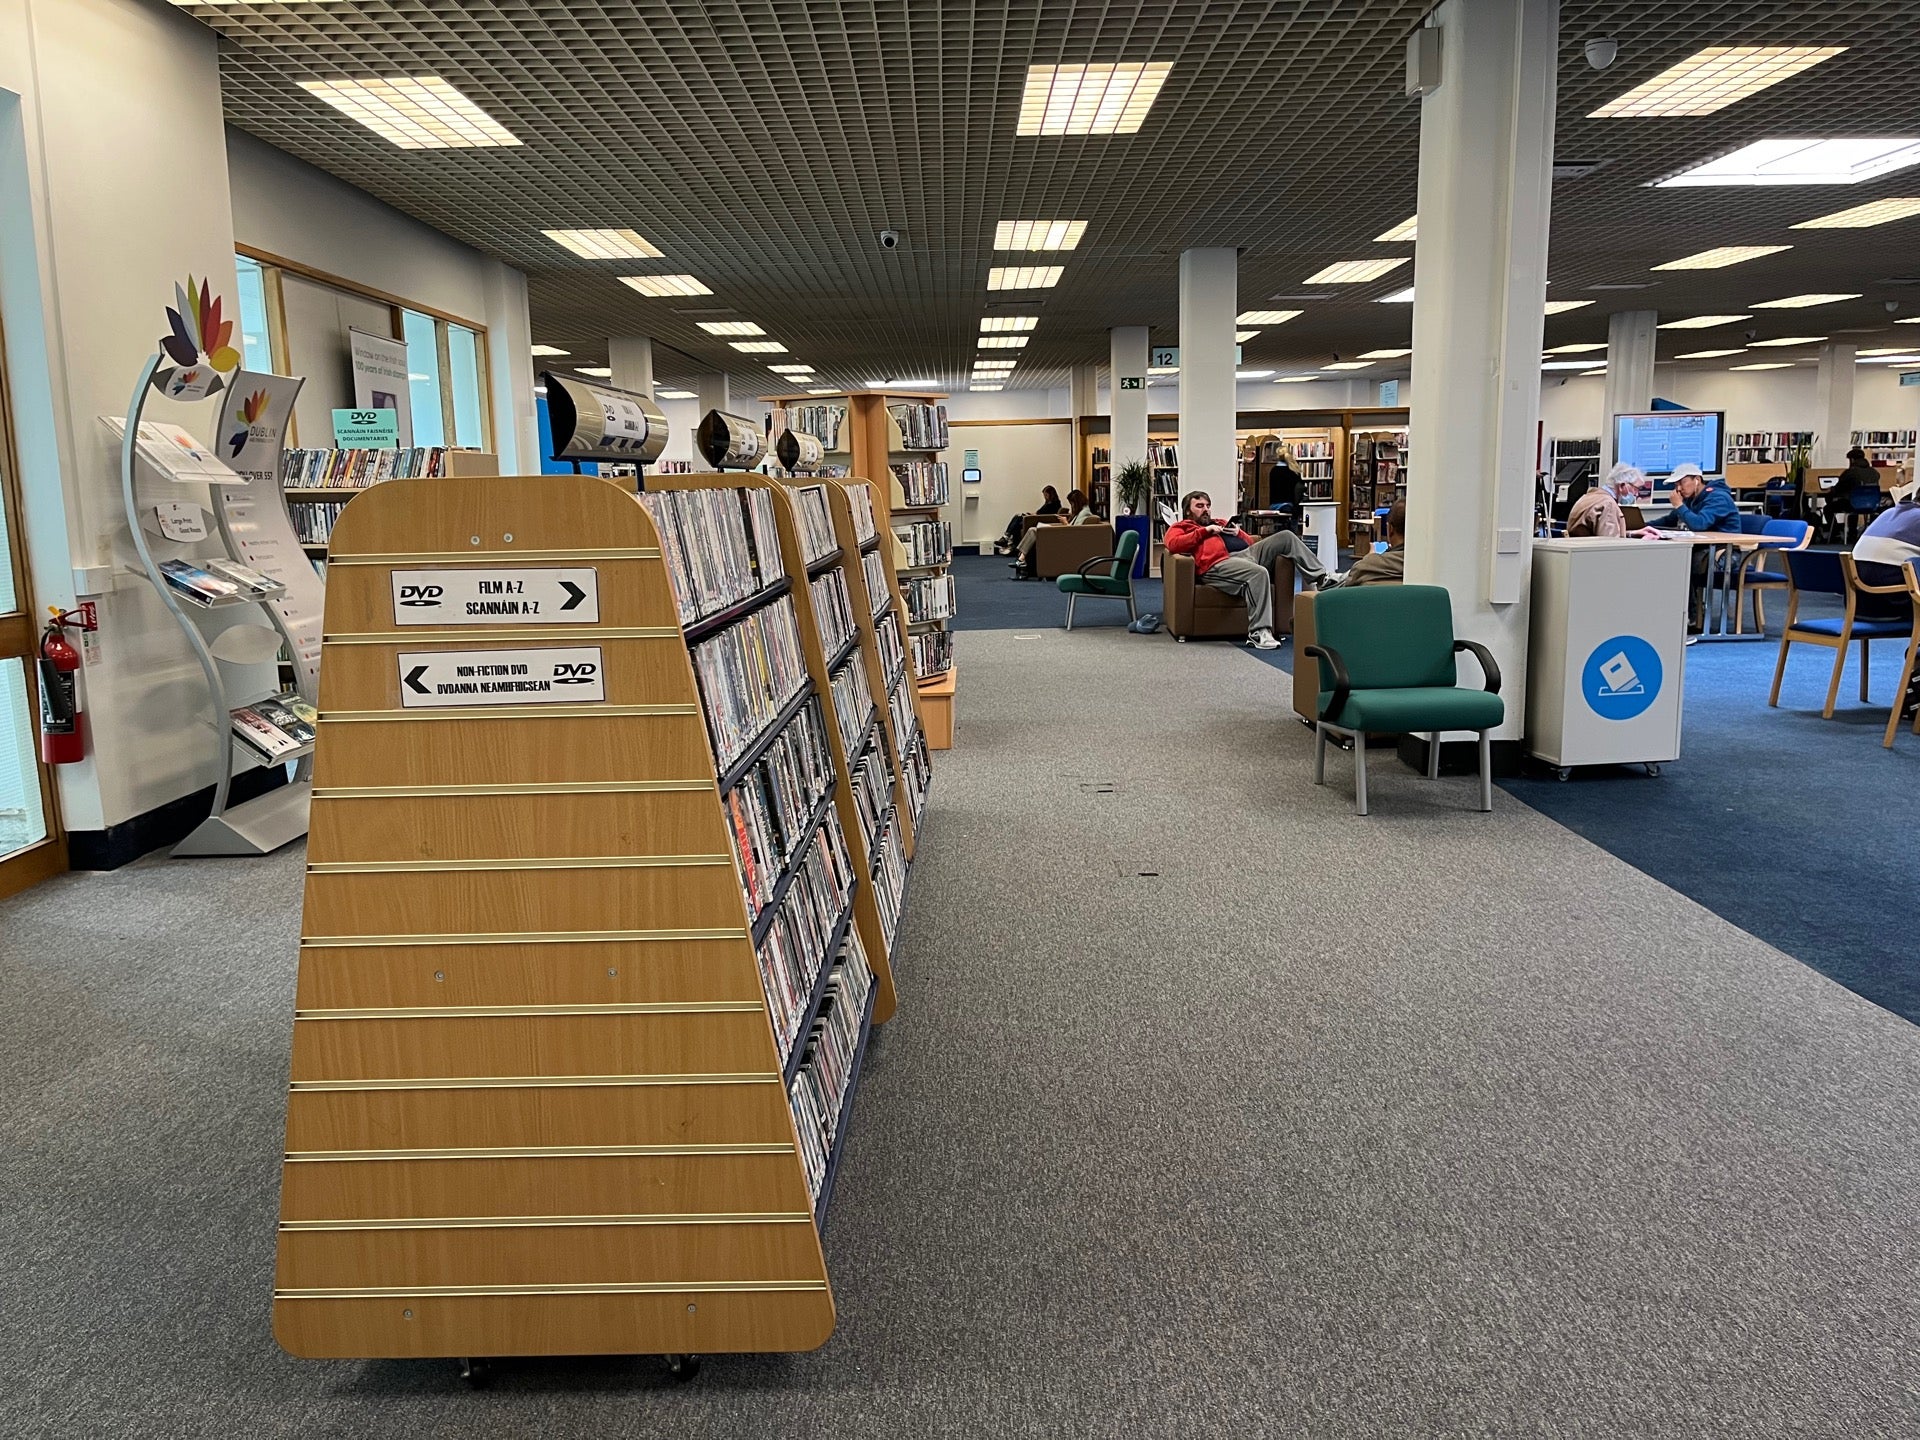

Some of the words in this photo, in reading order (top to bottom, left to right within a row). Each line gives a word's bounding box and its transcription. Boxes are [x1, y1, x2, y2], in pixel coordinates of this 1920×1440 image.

[1157, 353, 1173, 366] 12
[351, 411, 377, 420] DVD
[250, 426, 276, 438] DUBLIN
[400, 585, 443, 600] DVD
[479, 581, 503, 594] FILM
[506, 581, 524, 594] A-Z
[466, 599, 519, 615] SCANNÁIN
[522, 602, 540, 614] A-Z
[457, 665, 510, 677] NON-FICTION
[510, 664, 528, 675] DVD
[553, 663, 597, 678] DVD
[437, 682, 479, 695] DVDANNA
[480, 680, 551, 693] NEAMHFHICSEAN
